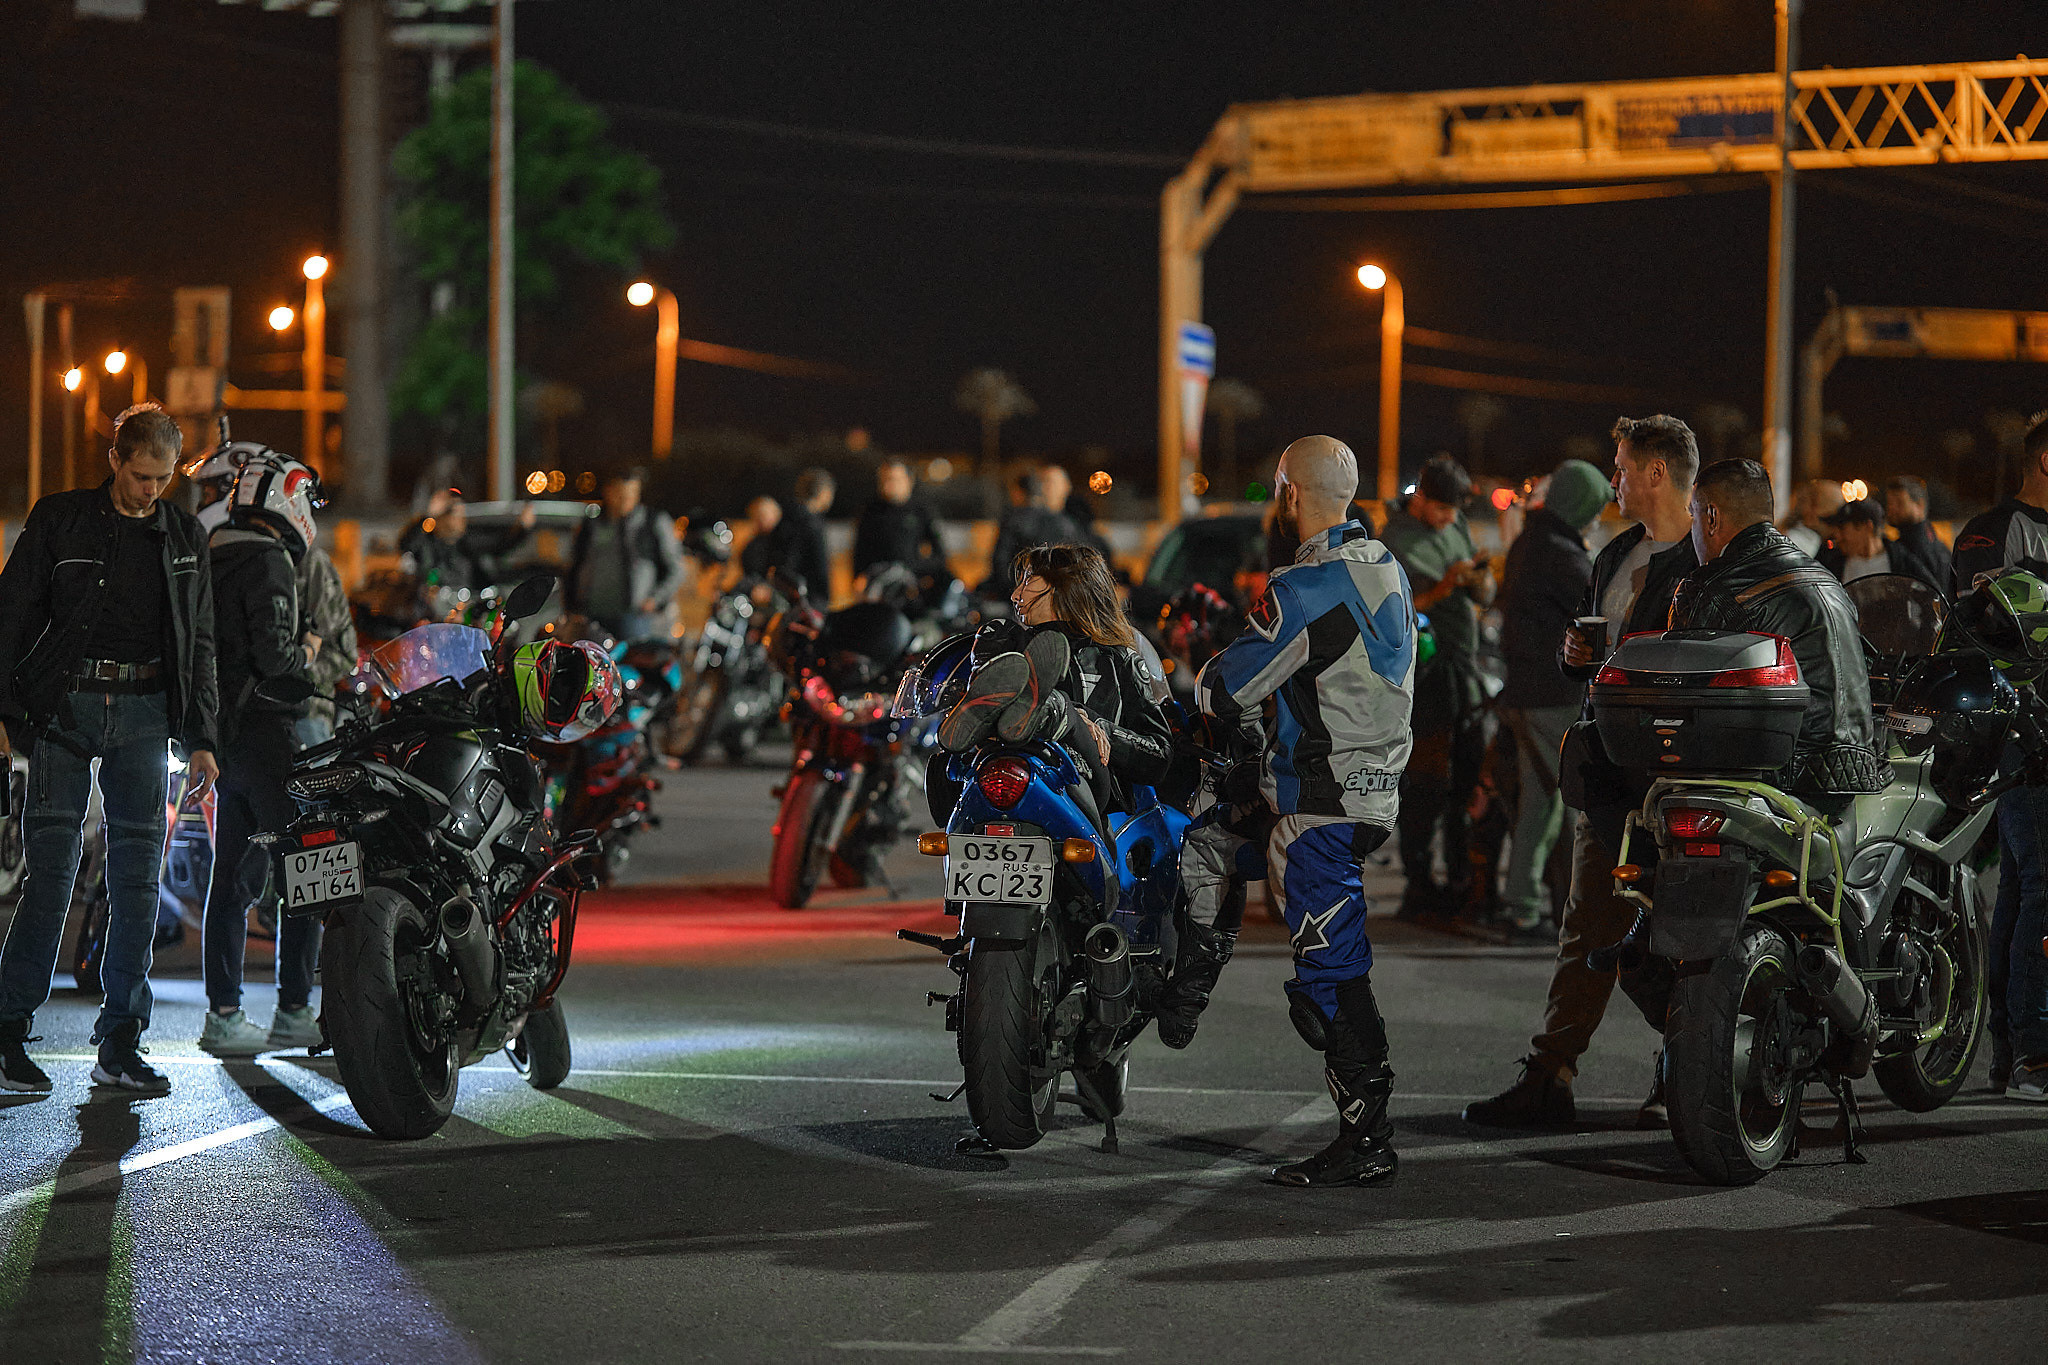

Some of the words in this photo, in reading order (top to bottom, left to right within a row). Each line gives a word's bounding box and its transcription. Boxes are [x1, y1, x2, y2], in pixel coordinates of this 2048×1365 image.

[295, 846, 348, 874] 0744
[964, 842, 1035, 862] 0367
[322, 868, 340, 878] RUS
[1002, 863, 1029, 873] RUS
[292, 881, 321, 905] AT
[329, 874, 356, 896] 64
[953, 872, 998, 897] KC
[1007, 874, 1043, 899] 23
